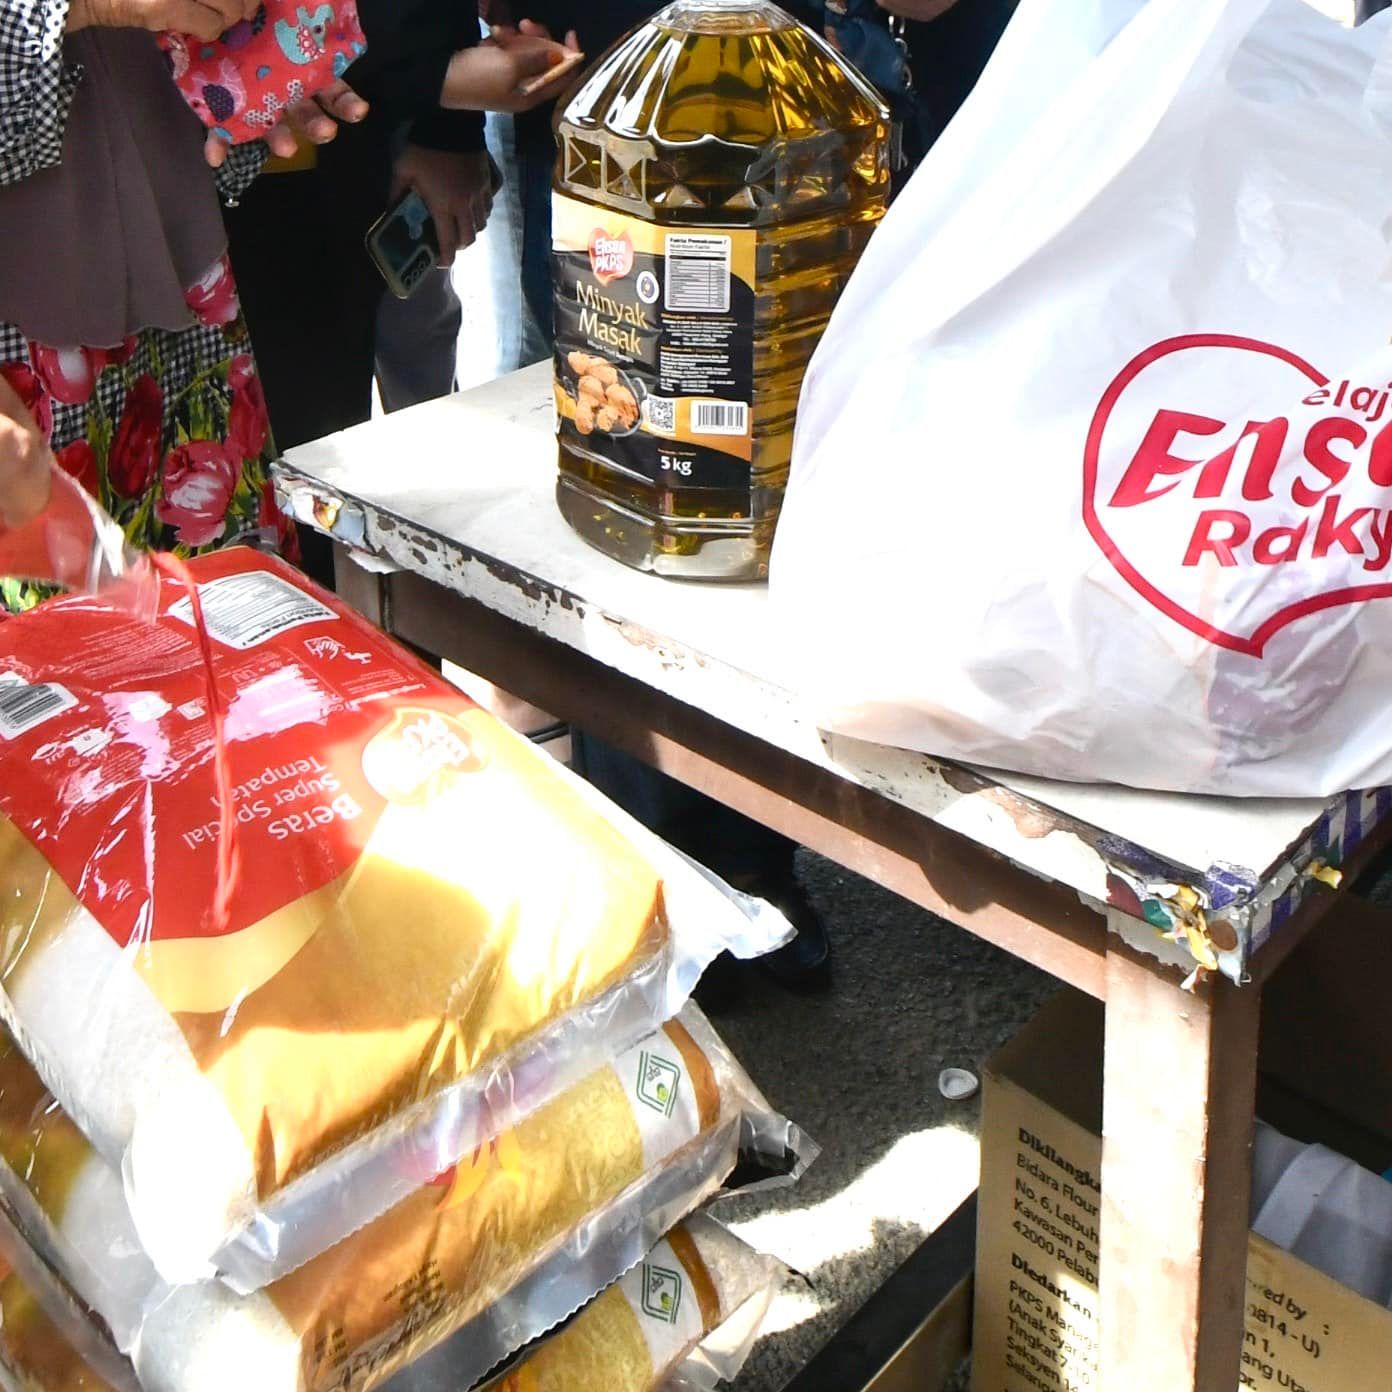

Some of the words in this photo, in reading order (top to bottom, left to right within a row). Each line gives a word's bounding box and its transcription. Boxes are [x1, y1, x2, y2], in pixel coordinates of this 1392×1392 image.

[576, 279, 649, 329] Minyak
[578, 308, 642, 356] Masak
[661, 455, 671, 470] 5
[672, 458, 693, 476] kg
[273, 772, 340, 806] Super
[182, 798, 273, 850] Spcial
[267, 792, 363, 840] Beras
[1015, 1177, 1038, 1203] No.
[1017, 1152, 1059, 1191] Bidara
[1062, 1183, 1099, 1216] Flour
[1012, 1220, 1055, 1256] 42000
[1013, 1197, 1074, 1248] Kawasan
[1009, 1279, 1044, 1313] PKPS
[1286, 1297, 1307, 1321] by
[1007, 1315, 1059, 1364] Tingkat
